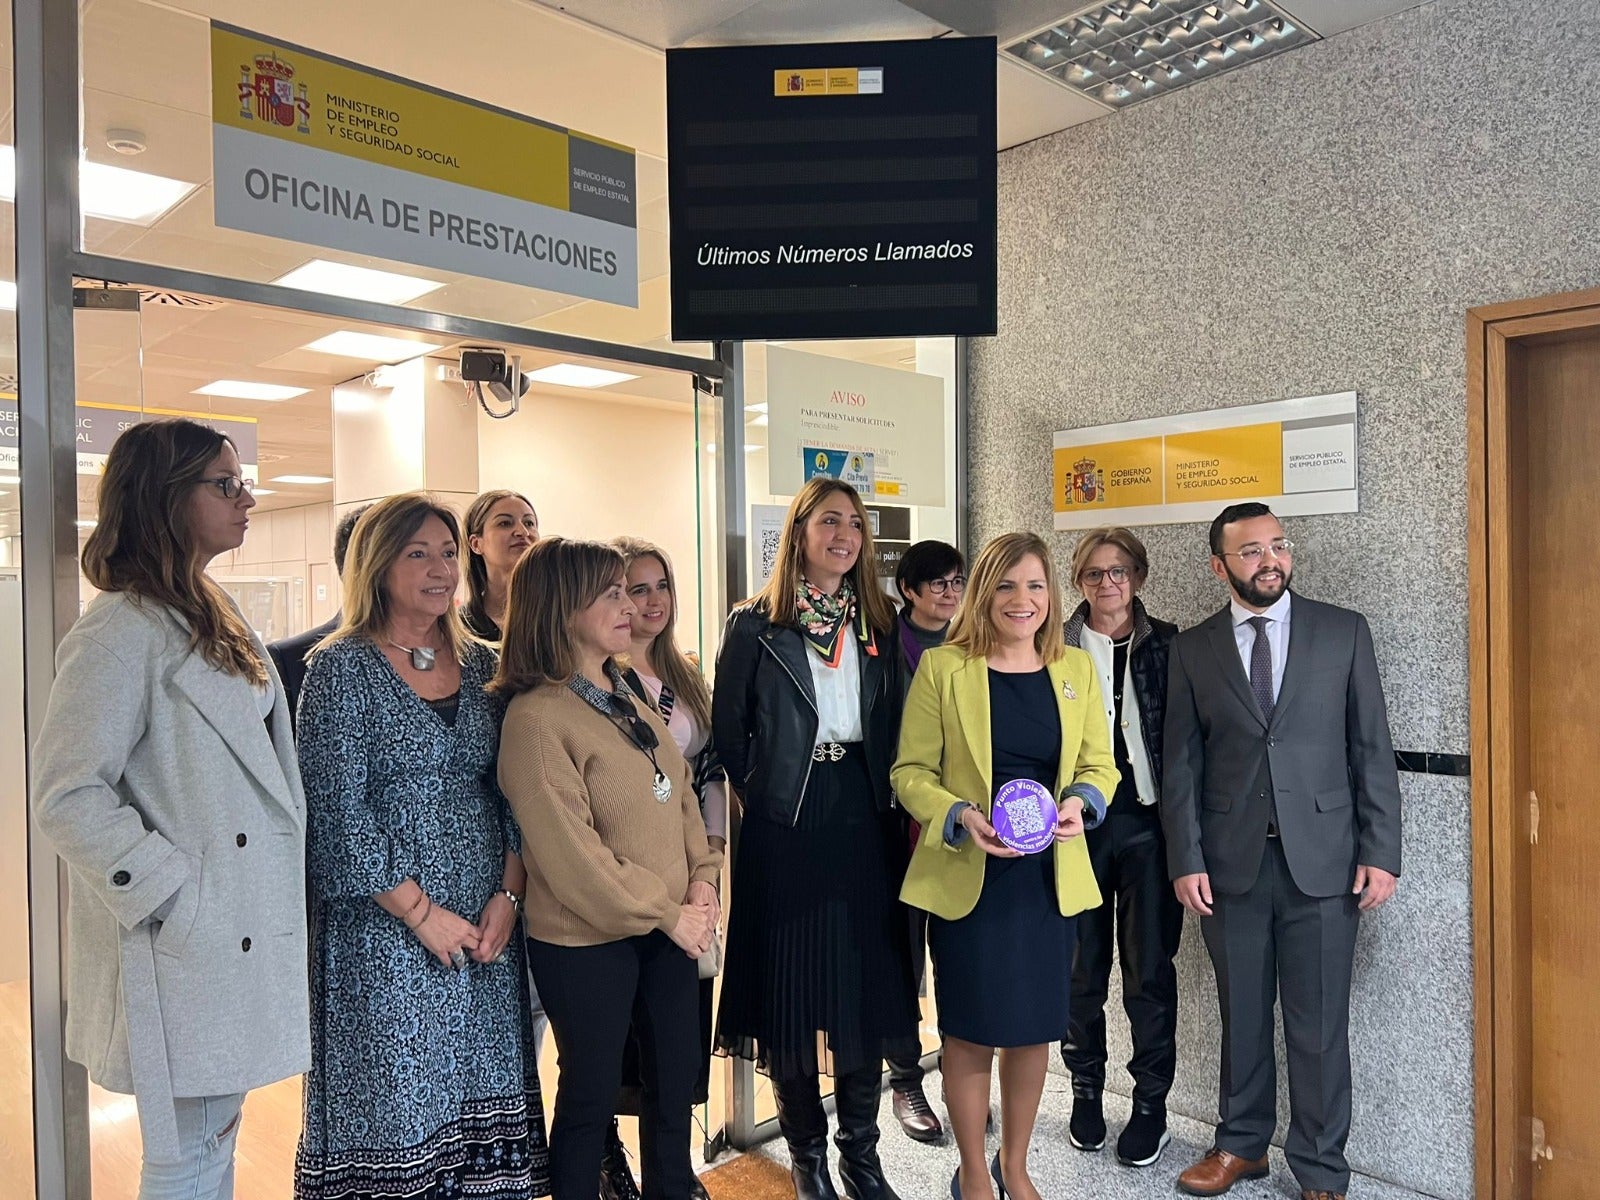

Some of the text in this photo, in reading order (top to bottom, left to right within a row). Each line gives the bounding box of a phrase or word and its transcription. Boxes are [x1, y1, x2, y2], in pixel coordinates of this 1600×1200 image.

[326, 93, 400, 123] MINISTERIO
[327, 108, 398, 137] DE EMPLEO
[327, 124, 460, 168] Y SEGURIDAD SOCIAL
[573, 167, 601, 181] SERVICIO
[573, 181, 631, 204] DE EMPLEO ESTATAL
[245, 168, 617, 276] OFICINA DE PRESTACIONES
[697, 240, 974, 265] Últimos Números Llamados
[830, 390, 866, 408] AVISO
[801, 408, 896, 428] PARA PRESENTAR SOLICITUDES
[1110, 467, 1152, 478] GOBIERNO
[1176, 459, 1220, 470] MINISTERIO
[1299, 460, 1321, 468] EMPLEO
[1111, 475, 1151, 487] DE ESPAÑA
[1176, 469, 1218, 480] DE EMPLEO
[1183, 478, 1228, 489] SEGURIDAD
[1229, 475, 1259, 485] SOCIAL
[996, 782, 1046, 808] Punto Violeta
